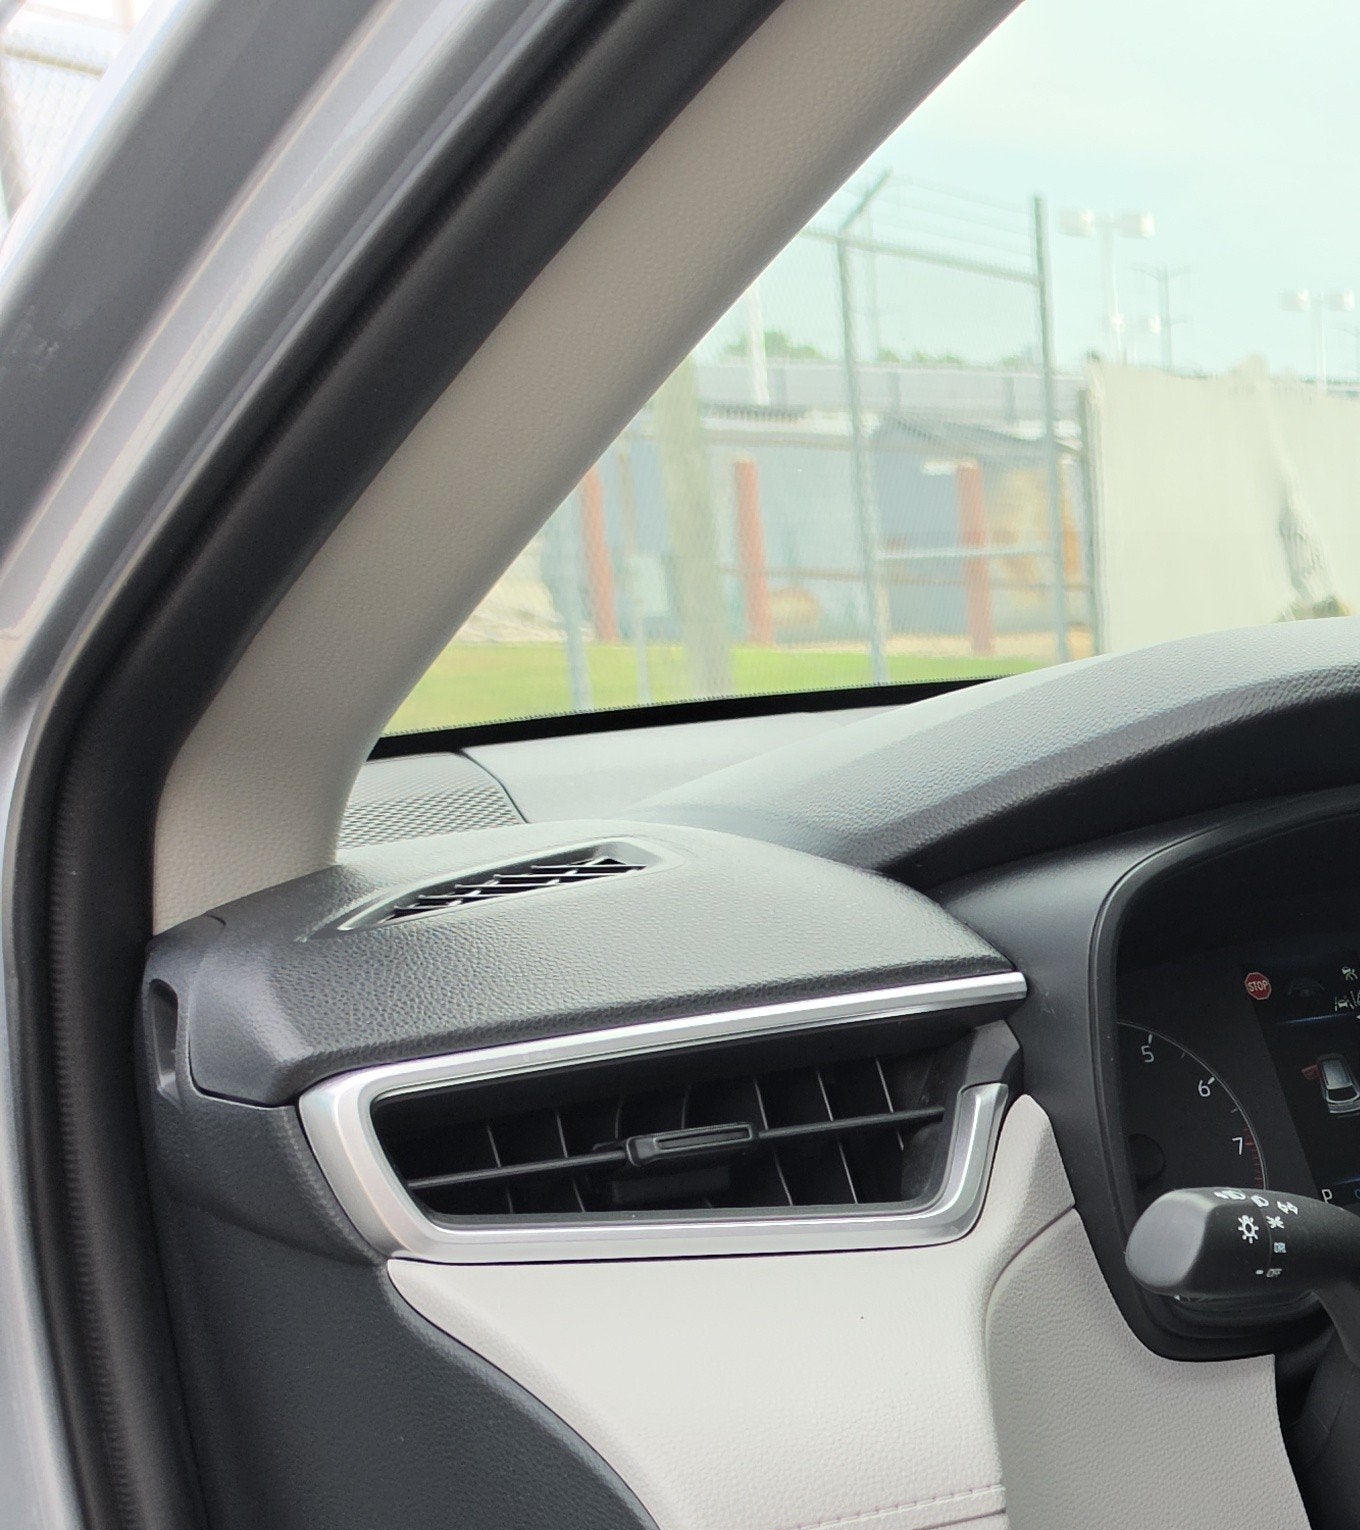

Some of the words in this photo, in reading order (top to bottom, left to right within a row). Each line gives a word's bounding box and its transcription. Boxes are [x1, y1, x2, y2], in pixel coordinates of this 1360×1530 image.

[1247, 980, 1269, 992] STOP
[1140, 1045, 1155, 1063] 5
[1198, 1080, 1211, 1097] 6
[1232, 1136, 1243, 1155] 7
[1321, 1188, 1333, 1204] P
